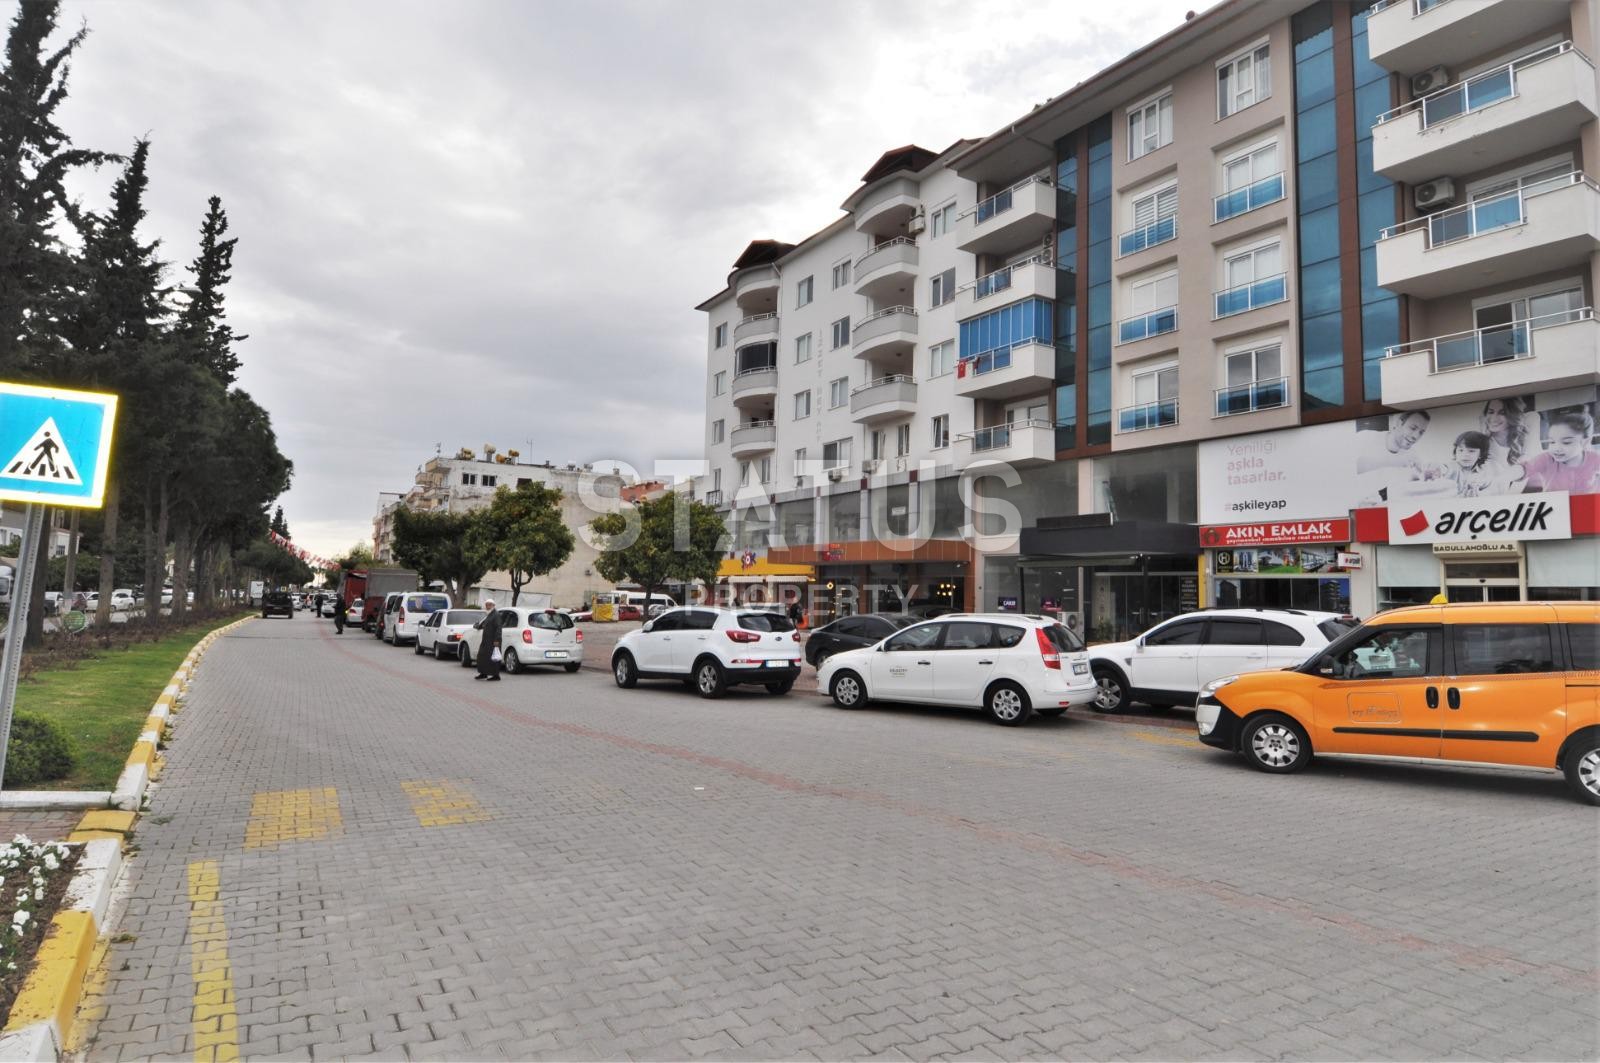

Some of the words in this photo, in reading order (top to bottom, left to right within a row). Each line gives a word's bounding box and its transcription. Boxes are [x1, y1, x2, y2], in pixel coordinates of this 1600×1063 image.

[1227, 456, 1264, 472] aşkla
[1434, 501, 1554, 540] arçelik
[1226, 525, 1265, 539] AKIN
[1271, 522, 1332, 536] EMLAK
